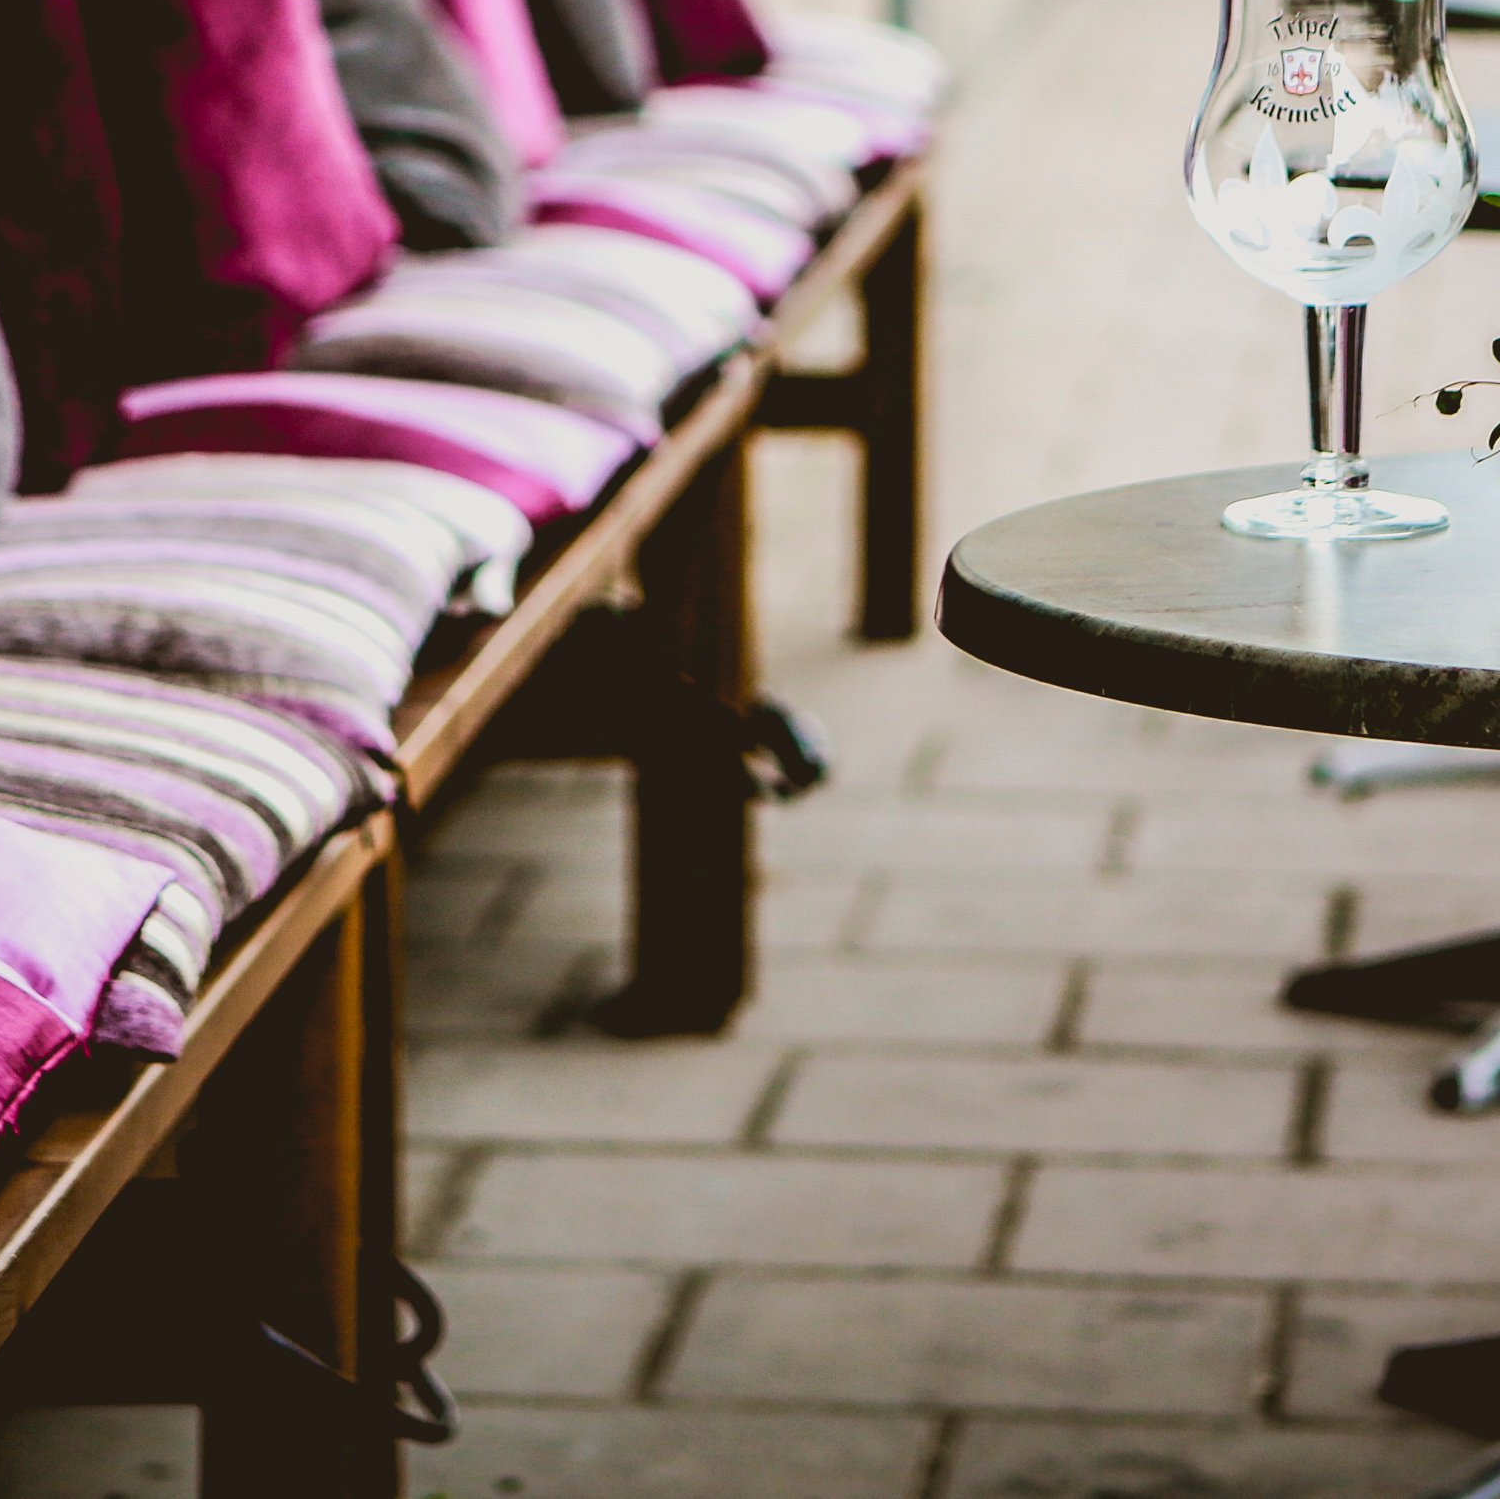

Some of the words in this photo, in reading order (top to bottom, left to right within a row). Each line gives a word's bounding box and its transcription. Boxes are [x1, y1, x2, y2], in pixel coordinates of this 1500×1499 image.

[1266, 11, 1339, 41] Tripel
[1324, 62, 1341, 77] 79
[1250, 84, 1356, 123] Karmeliet
